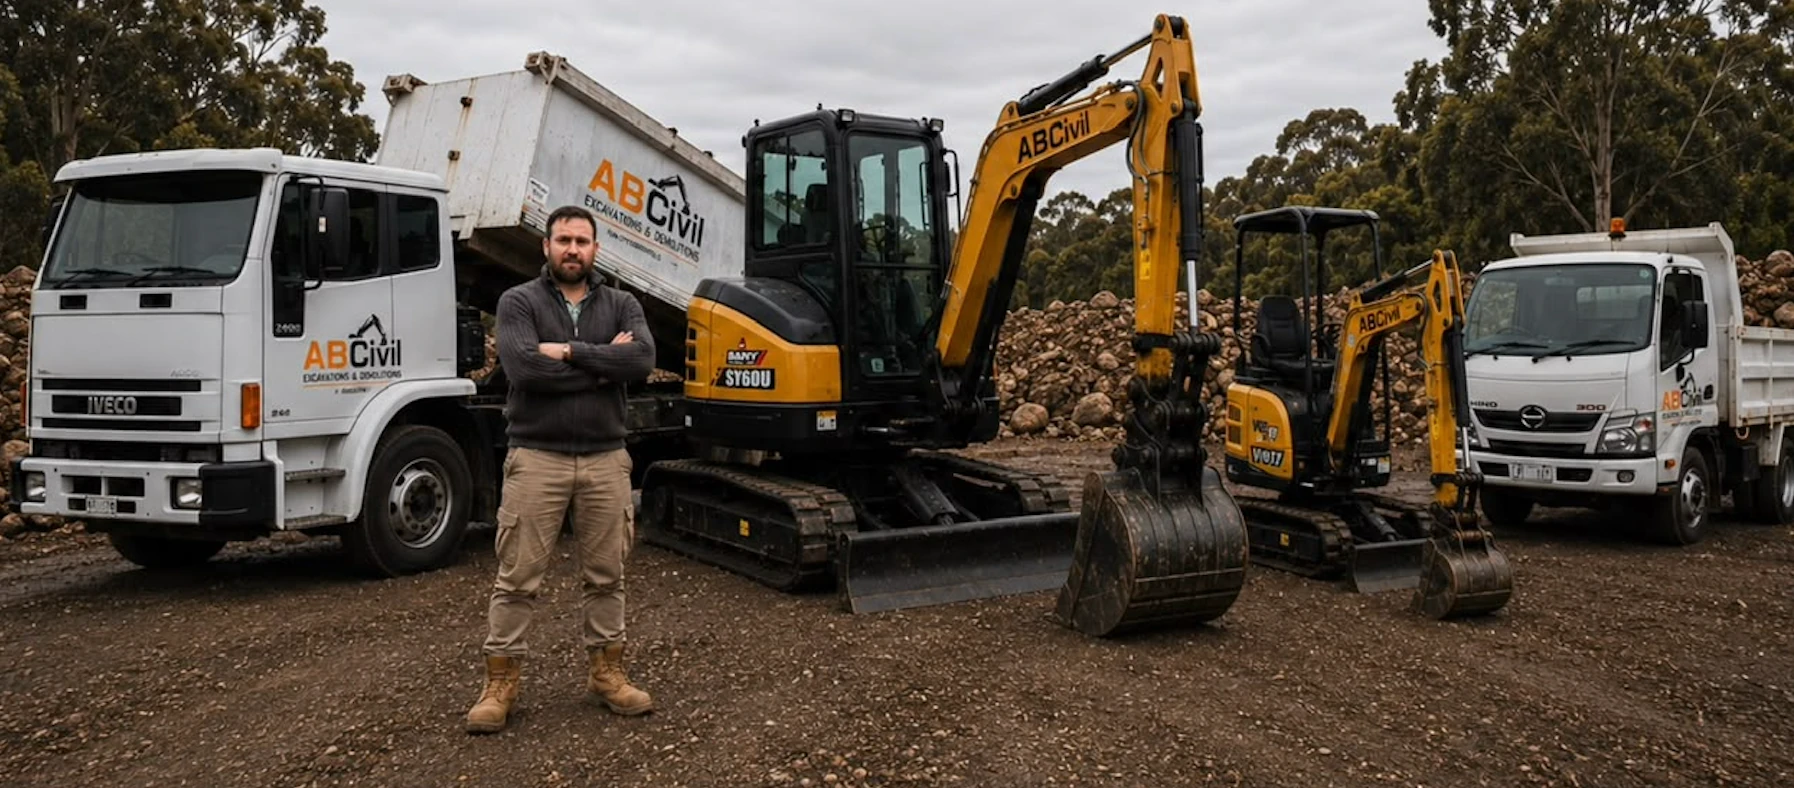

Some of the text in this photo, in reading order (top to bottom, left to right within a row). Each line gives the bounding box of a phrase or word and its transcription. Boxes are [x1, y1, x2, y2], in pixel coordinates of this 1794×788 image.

[1018, 110, 1090, 163] ABCivil
[584, 194, 643, 232] EXCAVATIONS
[588, 158, 704, 248] ABCivil
[1359, 304, 1400, 333] ABCivil
[303, 339, 402, 371] ABCivil
[725, 368, 771, 388] SY60U
[87, 396, 138, 414] IVECO
[1576, 403, 1607, 411] 300
